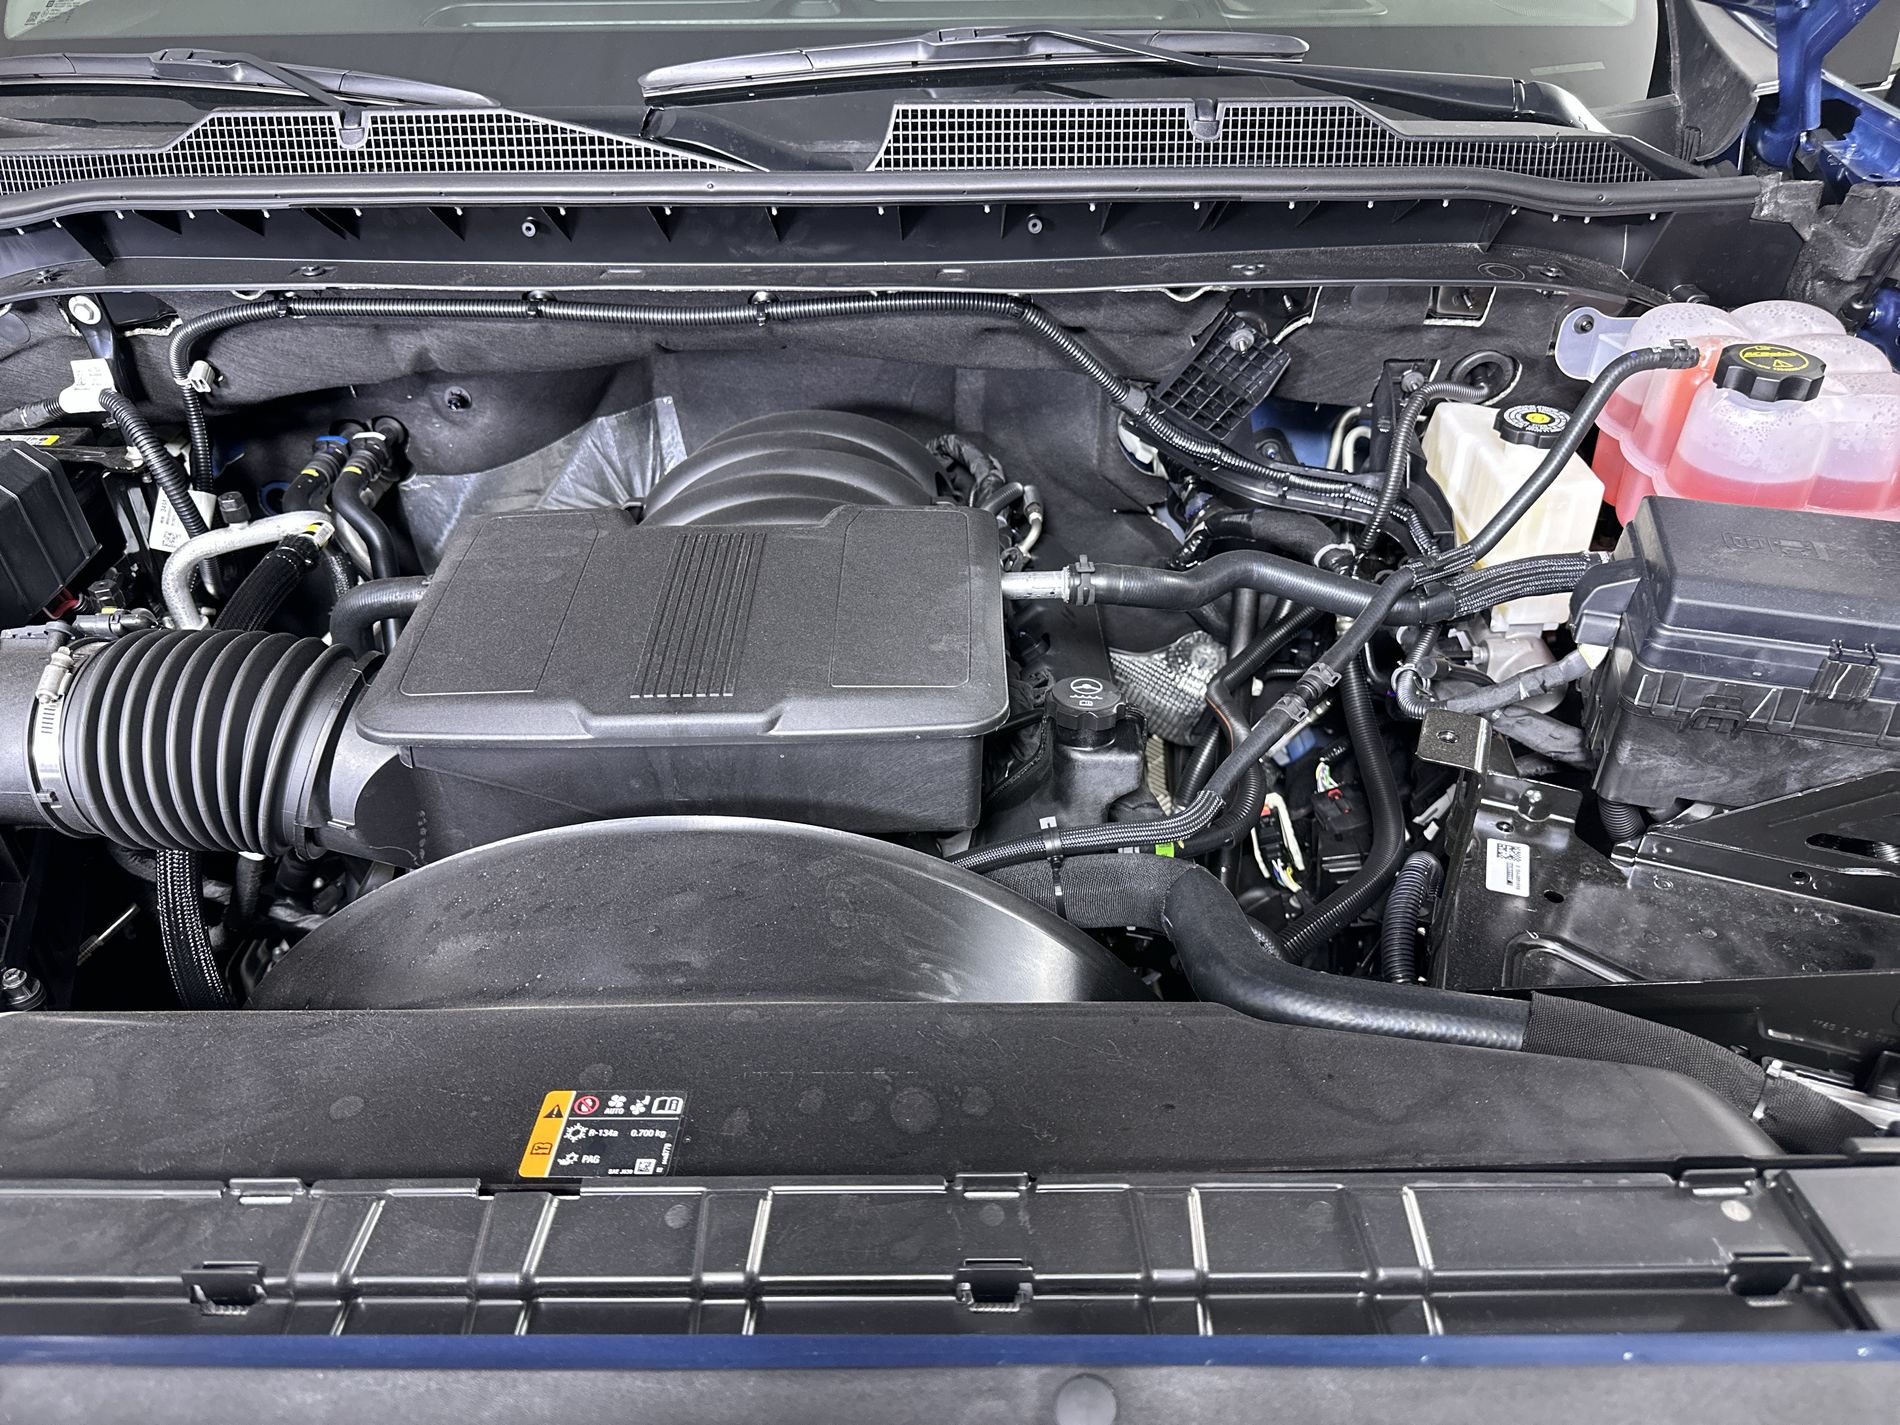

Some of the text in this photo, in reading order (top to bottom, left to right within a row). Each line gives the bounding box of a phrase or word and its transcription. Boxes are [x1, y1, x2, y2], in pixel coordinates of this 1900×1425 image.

[588, 1128, 667, 1139] R-134a 0.700 kg
[581, 1154, 601, 1164] PAG
